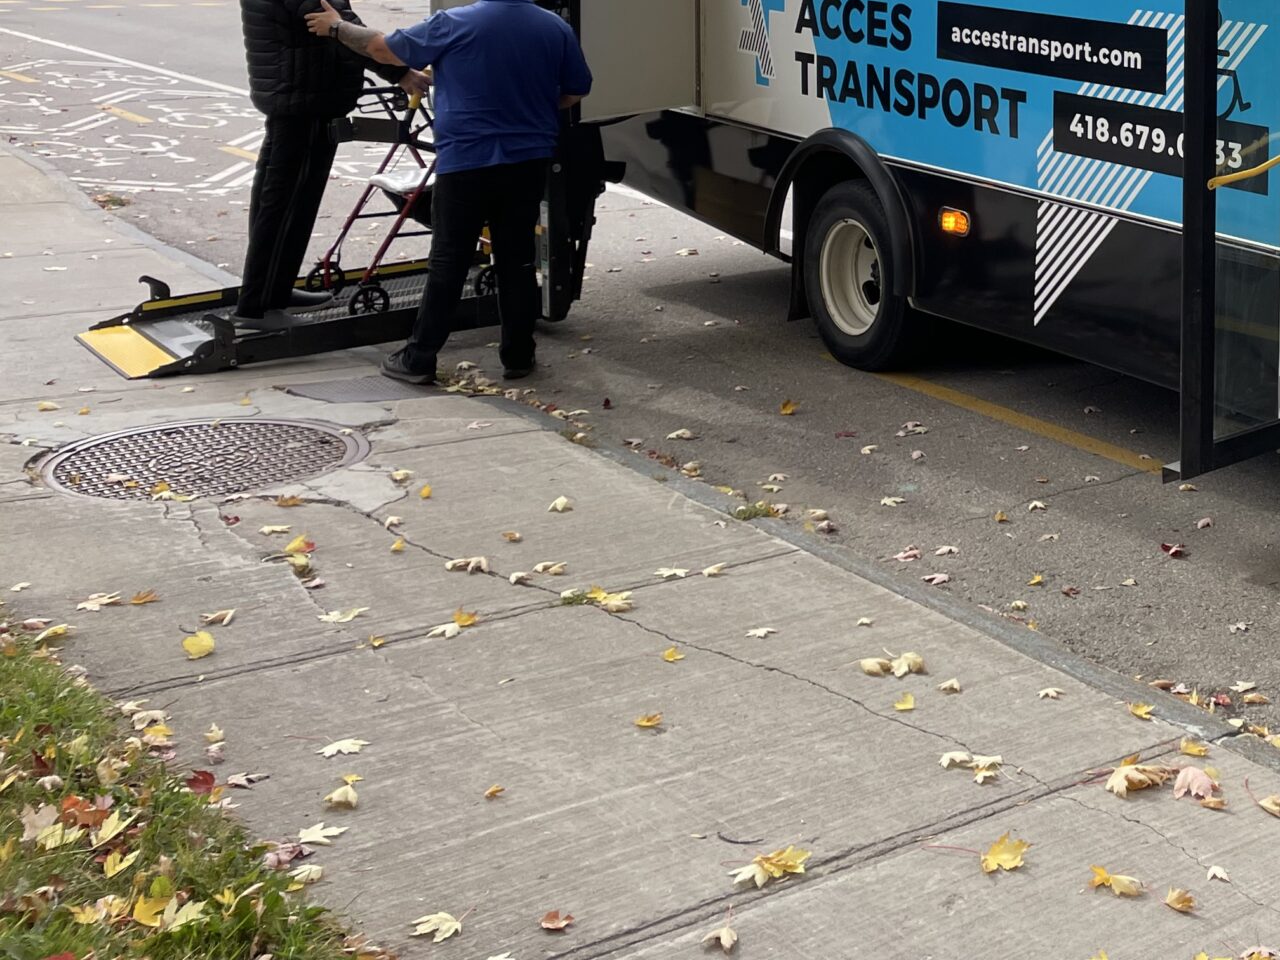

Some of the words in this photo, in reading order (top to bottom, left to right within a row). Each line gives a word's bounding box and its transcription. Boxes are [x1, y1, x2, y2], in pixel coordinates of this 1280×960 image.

[951, 26, 1142, 70] accestransport.com
[795, 51, 1027, 139] TRANSPORT
[1069, 113, 1243, 169] 418.679.33
